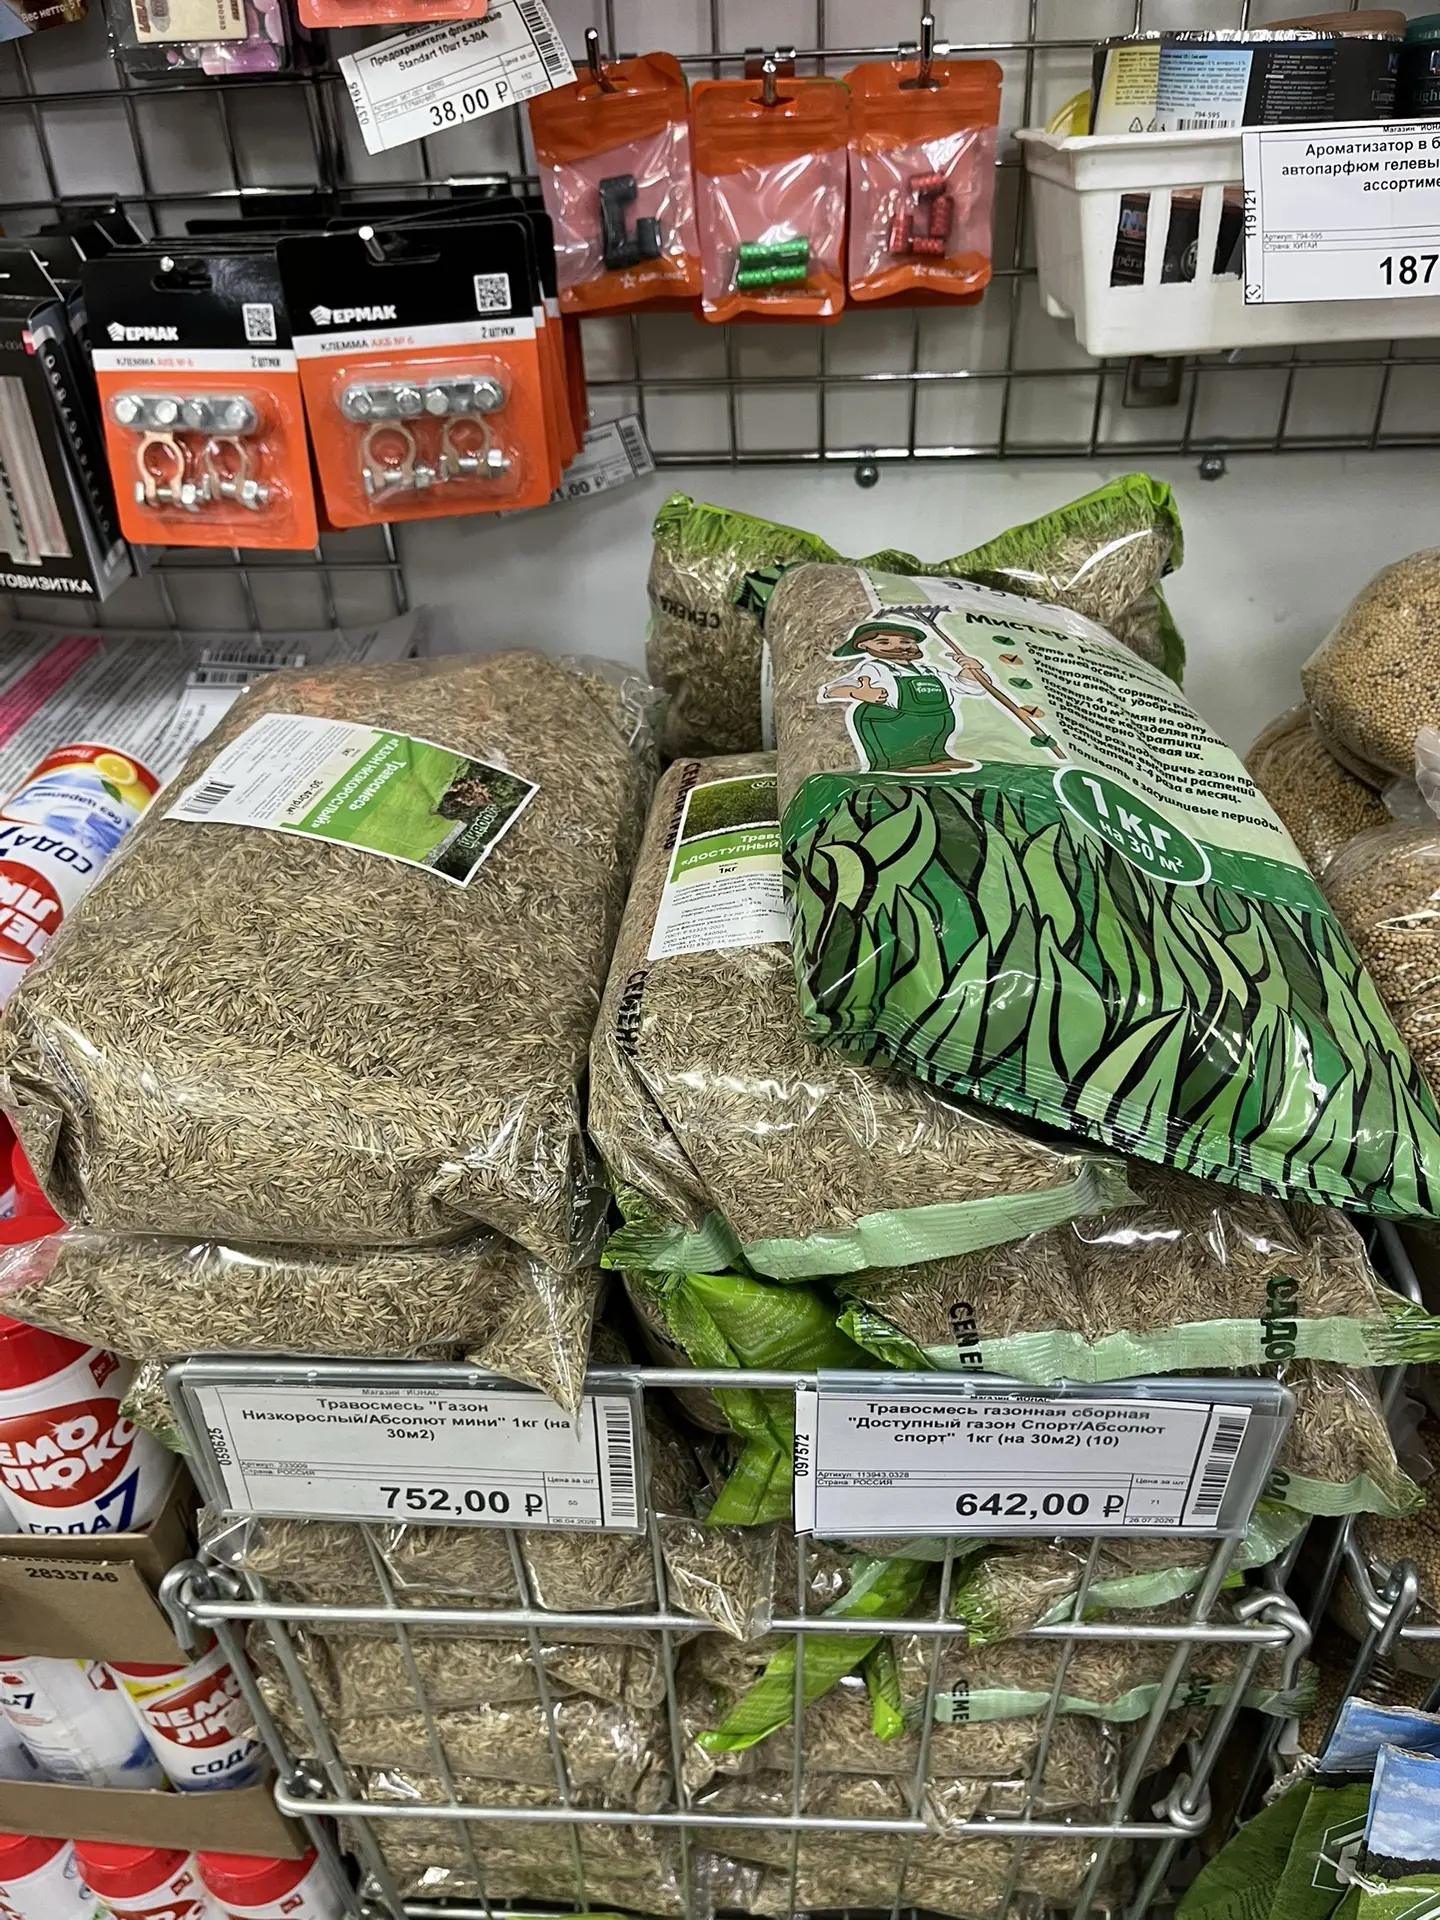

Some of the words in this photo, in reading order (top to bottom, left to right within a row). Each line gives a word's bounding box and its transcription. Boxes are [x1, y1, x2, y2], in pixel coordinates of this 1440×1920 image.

[370, 31, 448, 67] Предохранители
[448, 11, 503, 38] флажковые
[399, 48, 438, 71] Standart
[438, 40, 461, 55] 10шт
[429, 88, 490, 127] 38,00
[1194, 111, 1221, 119] 794-595
[1382, 125, 1415, 134] Магазин
[1305, 138, 1414, 159] Ароматизатор
[1418, 140, 1427, 150] в
[1282, 159, 1379, 177] автопарфюм
[1384, 157, 1440, 172] гелевы
[1363, 176, 1440, 193] ассортиме
[1245, 189, 1257, 239] 119121
[1293, 241, 1318, 250] КИТАЙ
[1379, 254, 1440, 286] 187
[333, 305, 398, 324] ЕРМАК
[125, 326, 179, 341] ЕРМАК
[481, 327, 488, 339] 2
[489, 325, 516, 338] ШТУКИ
[321, 339, 369, 352] КЛЕММА
[965, 611, 1069, 641] Мистер
[1033, 658, 1116, 692] Уничтожить
[1041, 677, 1093, 702] Посеять
[1159, 716, 1175, 727] на
[1177, 720, 1207, 735] одну
[1060, 704, 1134, 738] равномерно
[1185, 751, 1205, 761] их.
[1056, 711, 1103, 738] Первый
[1105, 735, 1126, 748] раз
[1198, 768, 1235, 782] газон
[1059, 719, 1137, 760] достижении
[1190, 777, 1256, 798] растений
[1093, 744, 1134, 767] затем
[1135, 762, 1154, 778] 3-4
[1156, 775, 1183, 793] раза
[1185, 787, 1194, 795] в
[1196, 788, 1242, 803] месяц.
[312, 763, 379, 829] НИЗКОРОСЛЫЙ»
[349, 760, 407, 811] Травосмесь
[1068, 742, 1131, 781] Поливать
[1132, 778, 1140, 786] в
[1141, 780, 1219, 817] засушливые
[1221, 809, 1283, 835] периоды.
[1099, 819, 1125, 846] на
[1128, 834, 1154, 861] 30
[14, 829, 94, 876] СОДА
[680, 841, 779, 866] «ДОСТУПНЫЙ
[719, 866, 738, 874] 1кг
[362, 1388, 400, 1396] Магазин
[316, 1398, 424, 1411] Травосмесь
[429, 1400, 489, 1413] "Газон
[867, 1403, 978, 1415] Травосмесь
[983, 1407, 1066, 1417] газонная
[1071, 1408, 1150, 1420] сборная
[242, 1410, 447, 1426] Низкорослый/Абсолют
[452, 1417, 506, 1428] мини"
[512, 1418, 539, 1429] 1кг
[544, 1418, 571, 1430] (на
[848, 1417, 961, 1431] "Доступный
[966, 1421, 1016, 1430] газон
[1021, 1419, 1166, 1435] Спорт/Абсолют
[386, 1428, 435, 1441] 30м2)
[894, 1433, 955, 1445] спорт"
[967, 1433, 994, 1444] 1кг
[998, 1433, 1026, 1445] (на
[1030, 1434, 1081, 1447] 30м2)
[1086, 1435, 1120, 1447] (10)
[210, 1427, 232, 1466] 059625
[795, 1434, 810, 1477] 097572
[277, 1469, 316, 1477] РОССИЯ
[547, 1476, 570, 1485] Цена
[1135, 1478, 1159, 1486] Цена
[379, 1487, 511, 1516] 752,00
[525, 1493, 543, 1517] ₽
[955, 1492, 1090, 1520] 642,00
[1103, 1494, 1125, 1518] ₽
[25, 1567, 119, 1583] 2833746
